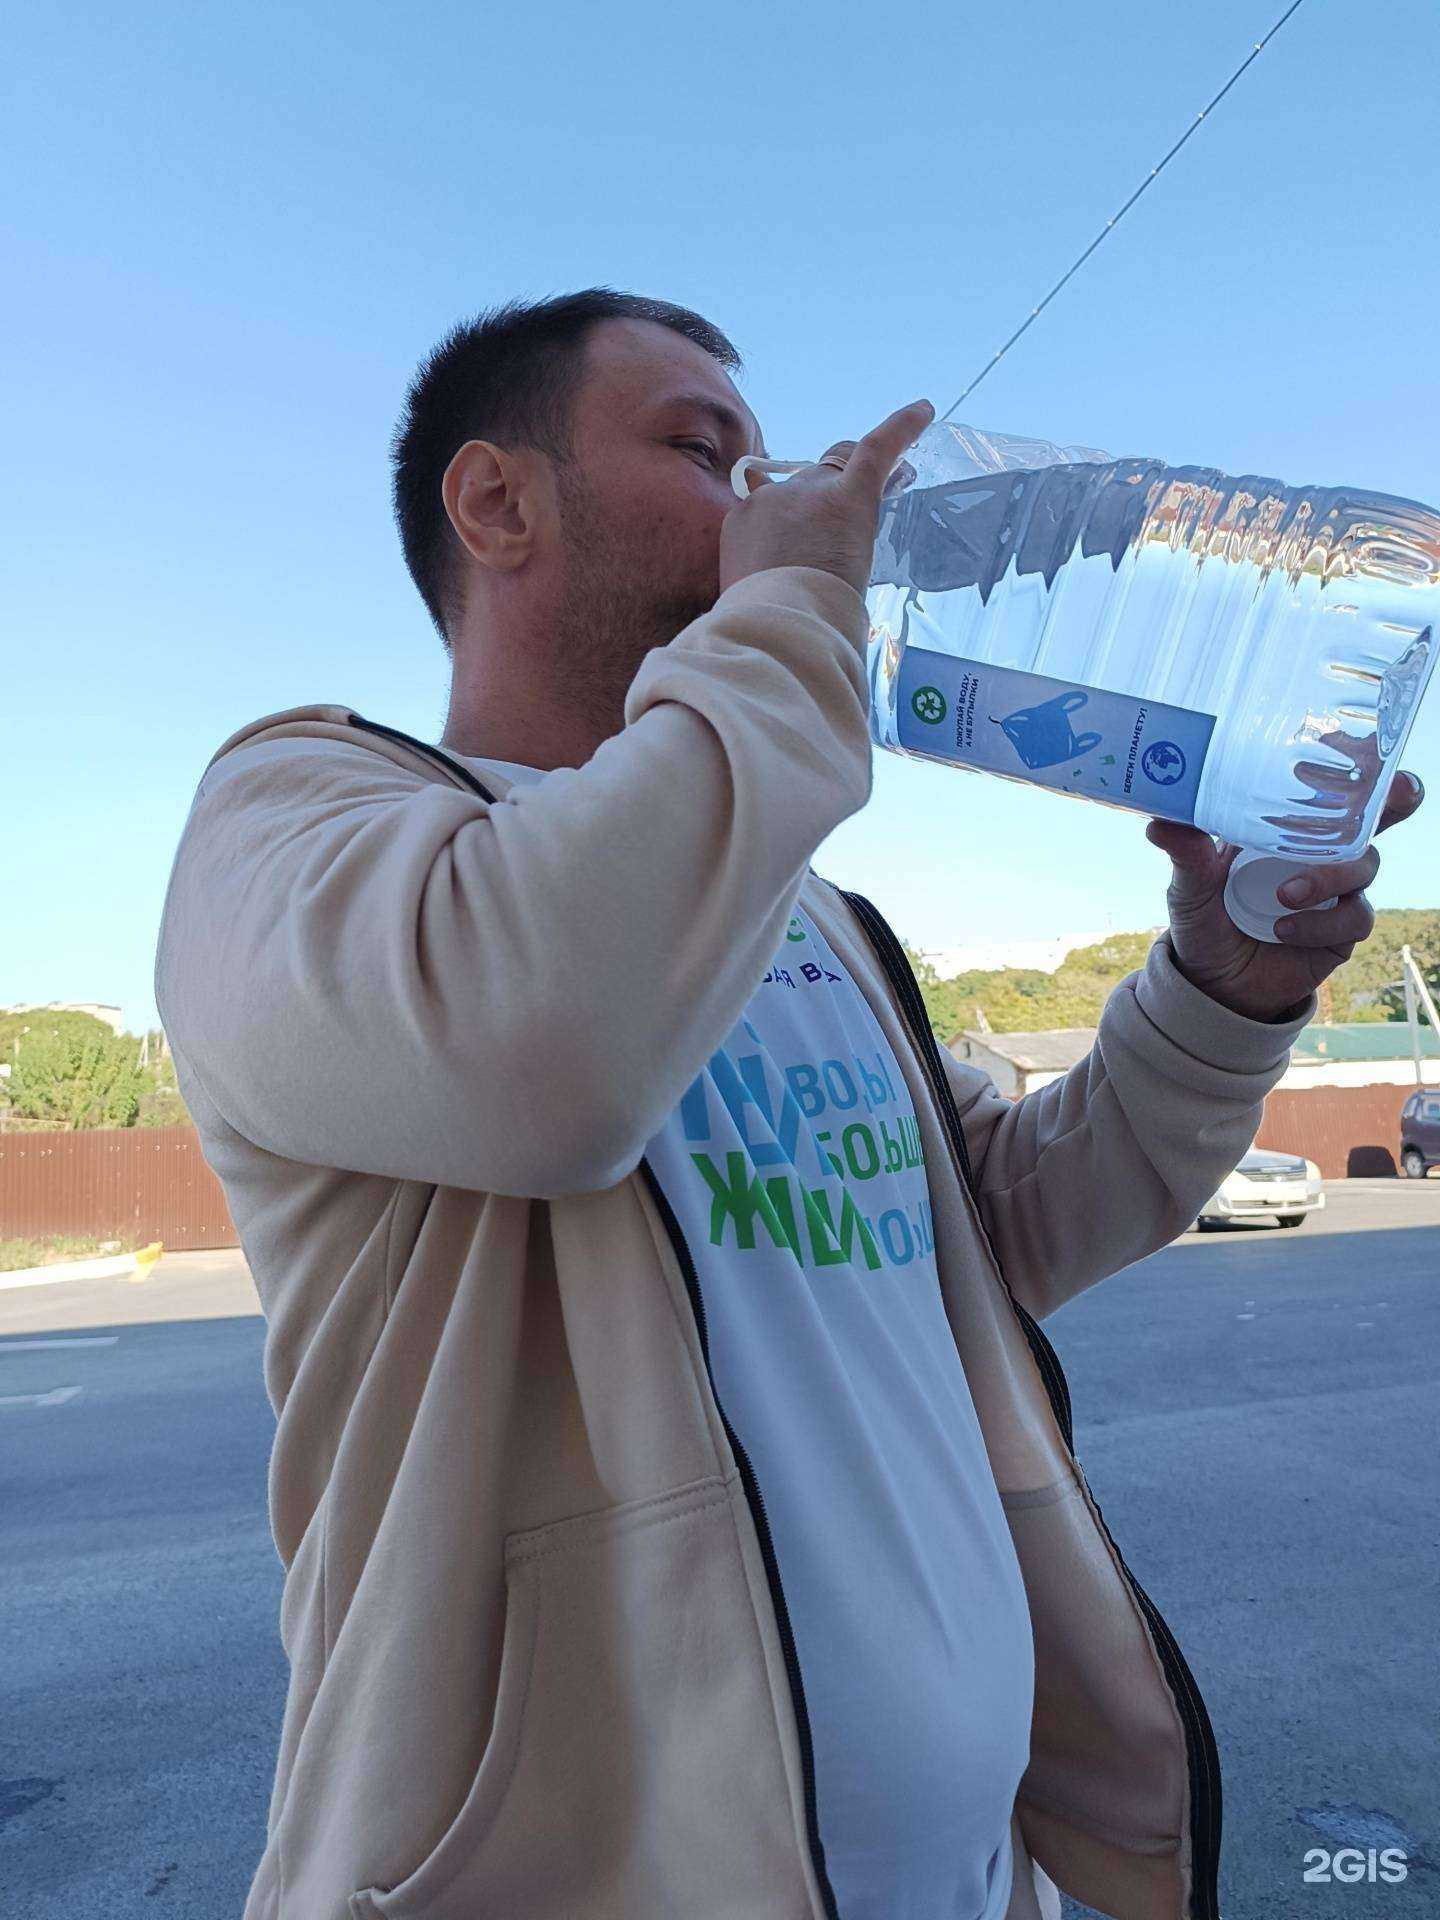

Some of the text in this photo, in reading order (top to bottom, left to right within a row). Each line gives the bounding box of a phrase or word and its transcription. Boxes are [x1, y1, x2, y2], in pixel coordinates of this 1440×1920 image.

[956, 672, 972, 748] ПОКУПАЙ ВОДУ,
[966, 678, 979, 727] БУТЫЛКИ
[966, 728, 973, 740] НЕ
[1123, 707, 1148, 794] БЕРЕГИ ПЛАНЕТУ!
[785, 1053, 897, 1118] ВОЫ
